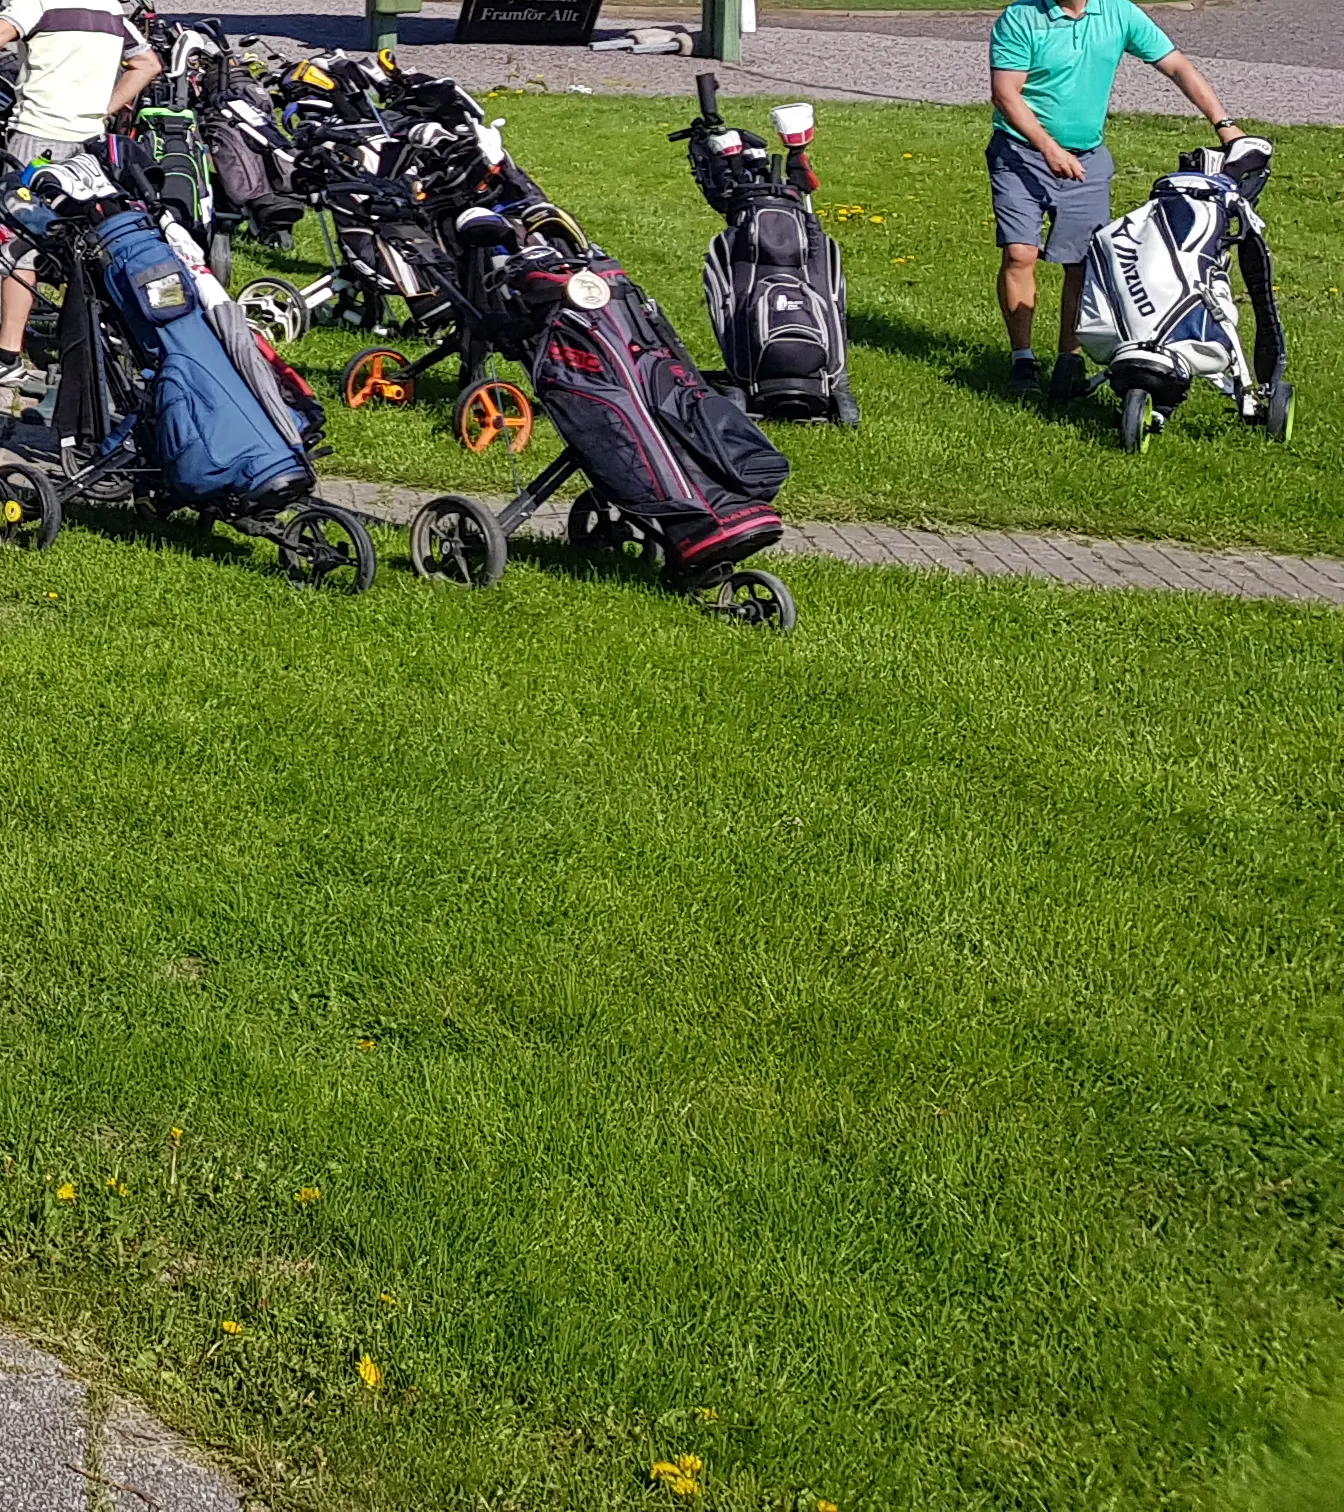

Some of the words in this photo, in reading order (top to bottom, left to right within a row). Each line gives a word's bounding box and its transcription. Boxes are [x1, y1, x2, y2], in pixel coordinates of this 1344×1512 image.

[480, 7, 546, 21] Framför
[547, 9, 581, 22] Allt
[1113, 243, 1156, 318] MIZUNO
